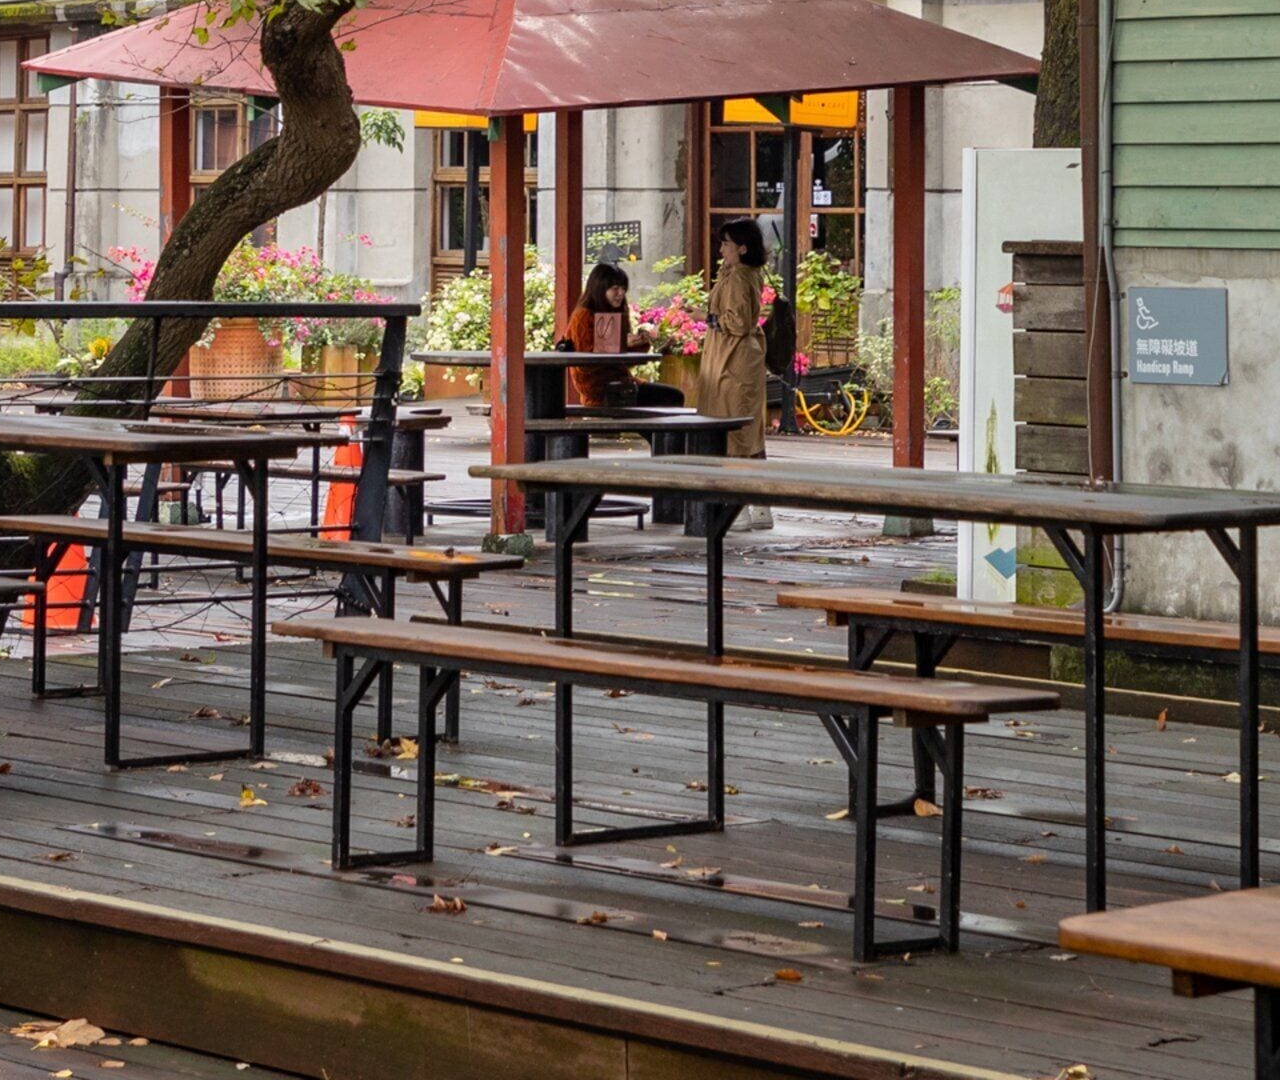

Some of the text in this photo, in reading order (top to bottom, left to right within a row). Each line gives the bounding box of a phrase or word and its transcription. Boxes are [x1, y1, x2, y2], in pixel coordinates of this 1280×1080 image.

[1136, 338, 1198, 357] 無障礙坡道
[1136, 359, 1194, 377] Handicap Ramp
